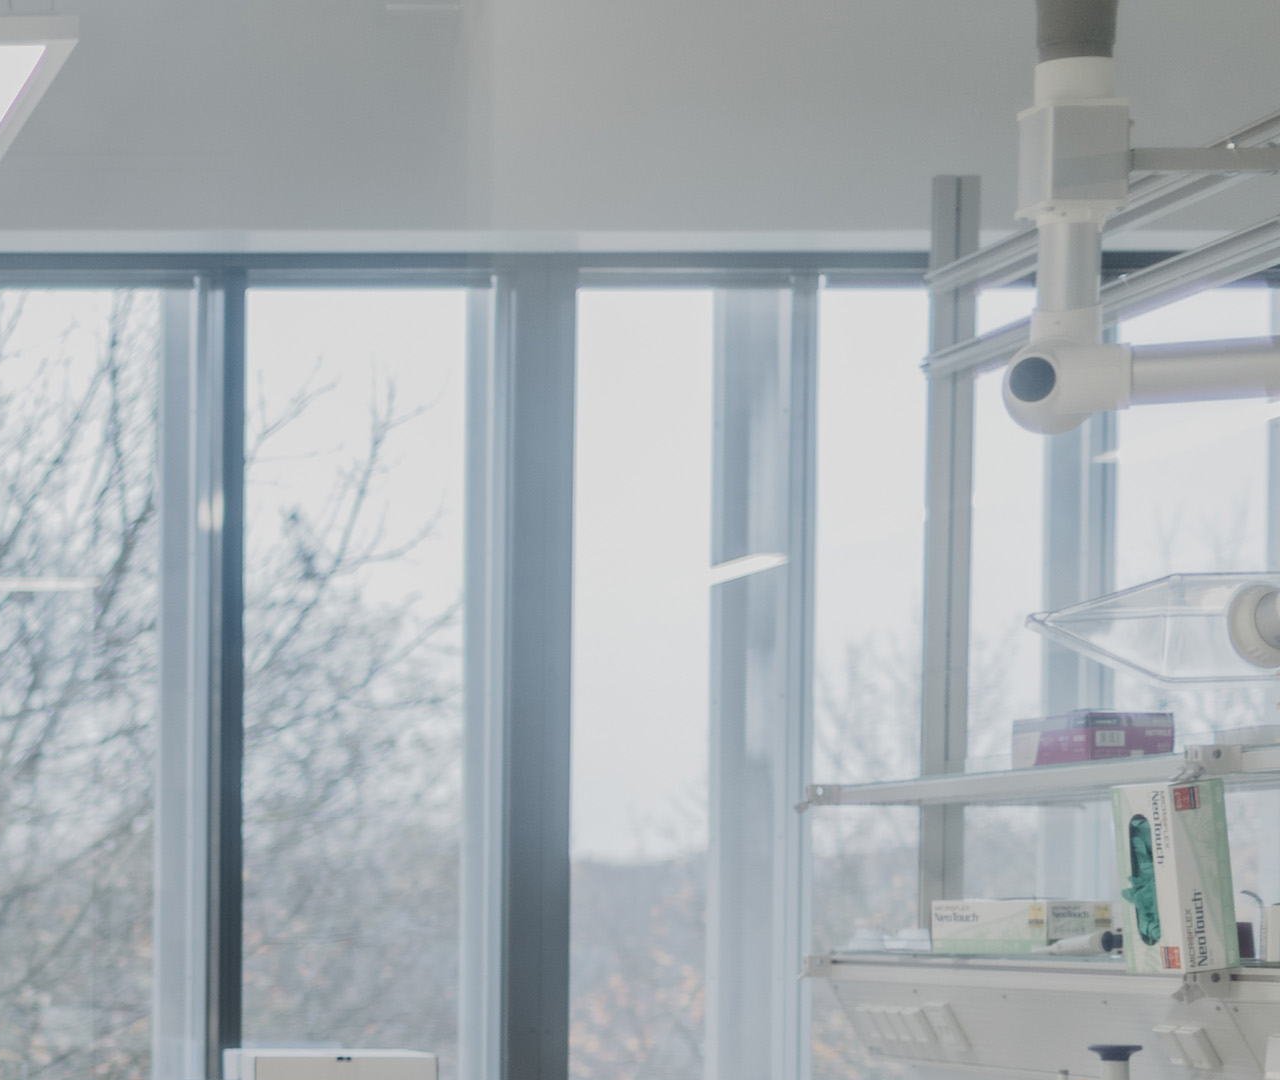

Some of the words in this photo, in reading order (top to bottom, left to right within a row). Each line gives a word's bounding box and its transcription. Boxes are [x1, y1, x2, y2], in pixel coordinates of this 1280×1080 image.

[1151, 790, 1165, 865] NeoTouch
[934, 912, 979, 922] NeoTouch
[1192, 891, 1208, 967] NeoTouch
